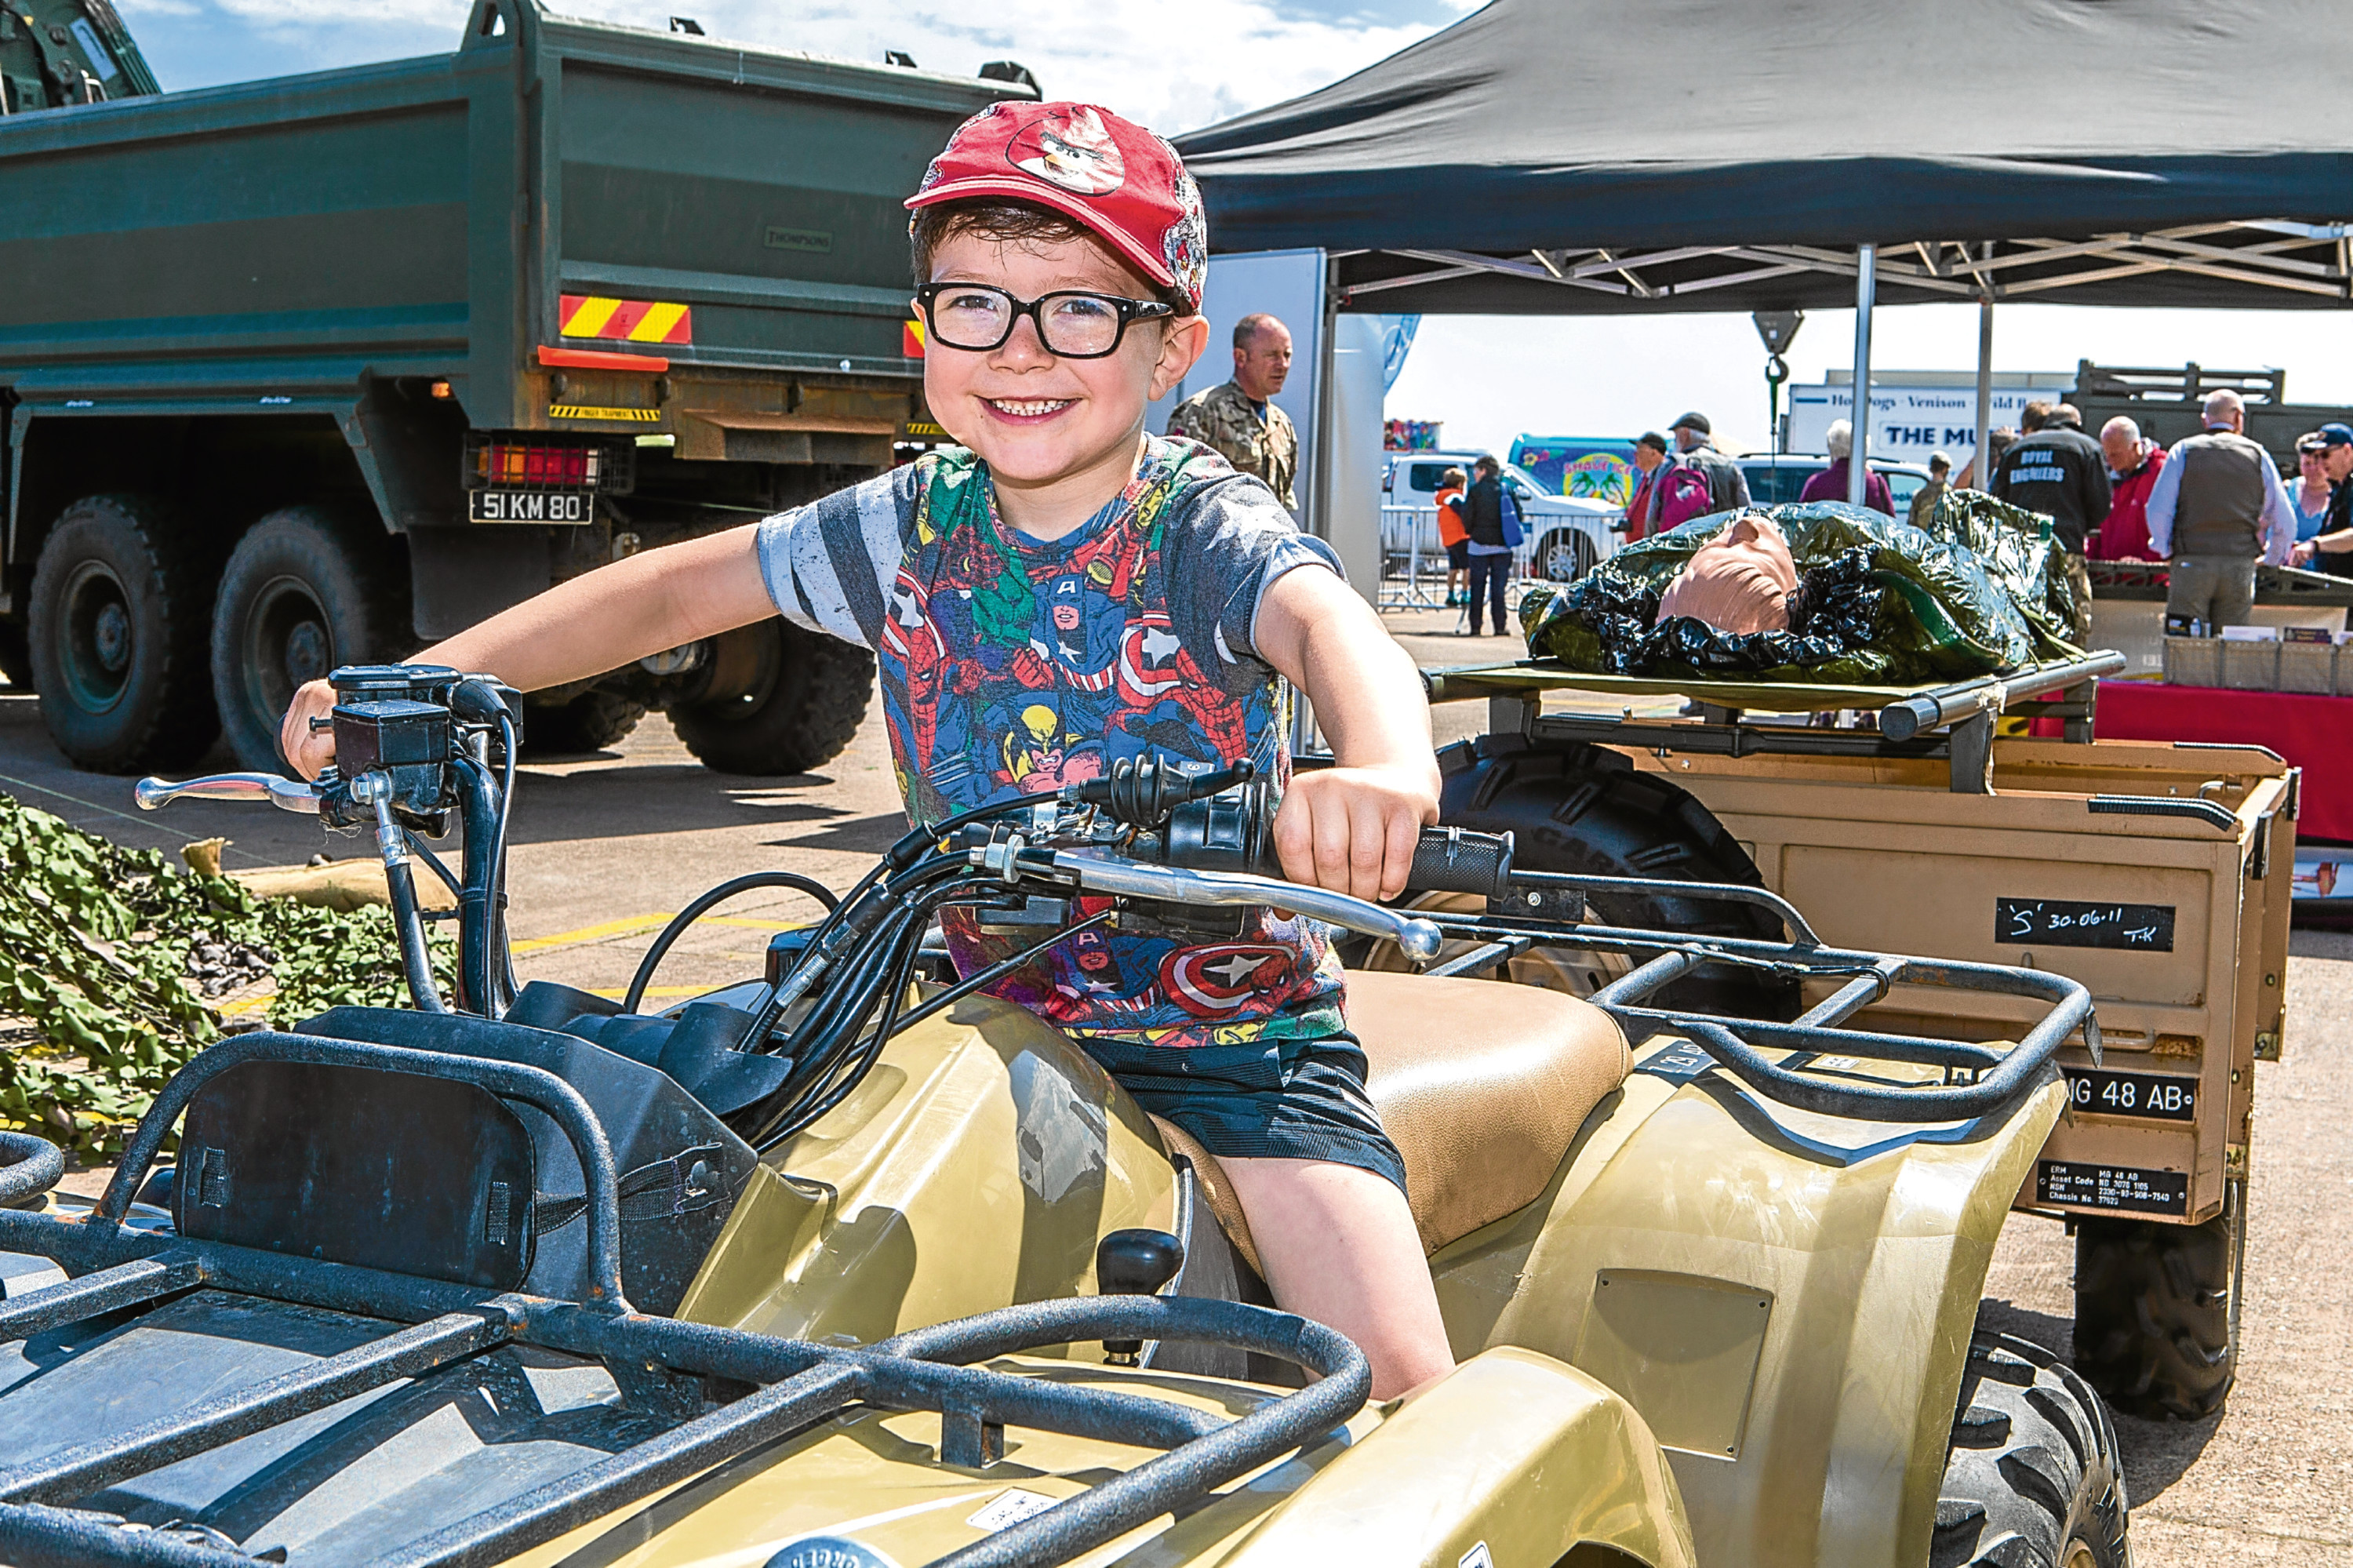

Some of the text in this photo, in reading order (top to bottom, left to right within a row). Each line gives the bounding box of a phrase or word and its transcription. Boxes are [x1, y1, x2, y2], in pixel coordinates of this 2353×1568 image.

[1832, 395, 1853, 406] Ho
[1868, 397, 1897, 412] ogs
[1908, 395, 1966, 408] Venison
[1993, 397, 2013, 408] ild
[1886, 427, 1977, 446] THE MU
[2020, 449, 2053, 464] ROYAL
[2009, 466, 2064, 484] ENGINEERS
[483, 493, 580, 519] 51 KM 80
[1056, 580, 1076, 595] A
[1078, 932, 1099, 945] A
[2102, 1080, 2136, 1108] 48
[2147, 1084, 2182, 1111] AB
[2050, 1165, 2139, 1181] ERM MG 48 AB
[2050, 1174, 2071, 1184] Asset
[2075, 1176, 2094, 1186] Code
[2049, 1183, 2065, 1191] NSN
[2049, 1191, 2078, 1202] Chassis
